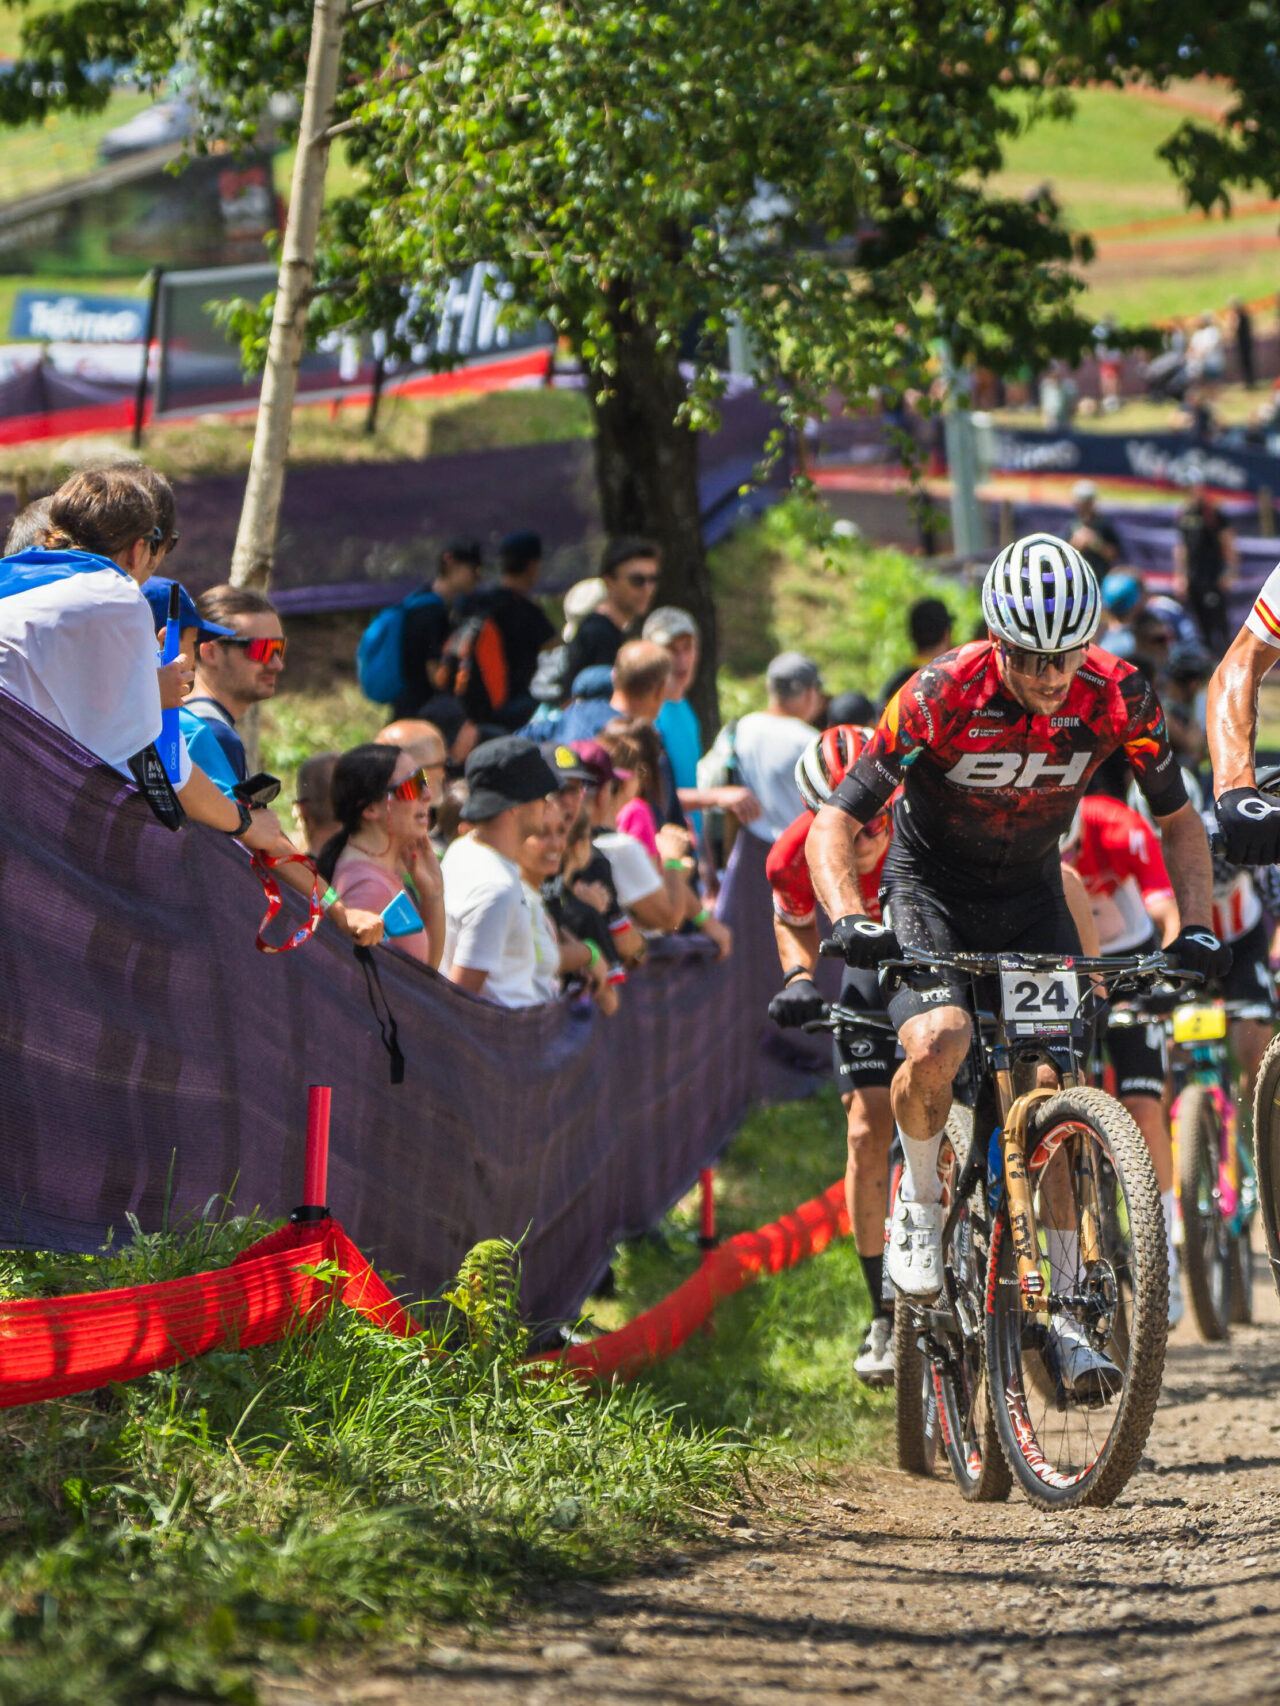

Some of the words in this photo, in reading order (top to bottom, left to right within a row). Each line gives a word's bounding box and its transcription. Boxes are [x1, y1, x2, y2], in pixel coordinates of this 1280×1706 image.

[1050, 716, 1081, 729] GOBIK
[944, 752, 1093, 789] BH
[921, 989, 951, 1003] FOX
[1014, 980, 1070, 1013] 24
[839, 1059, 888, 1076] maxon
